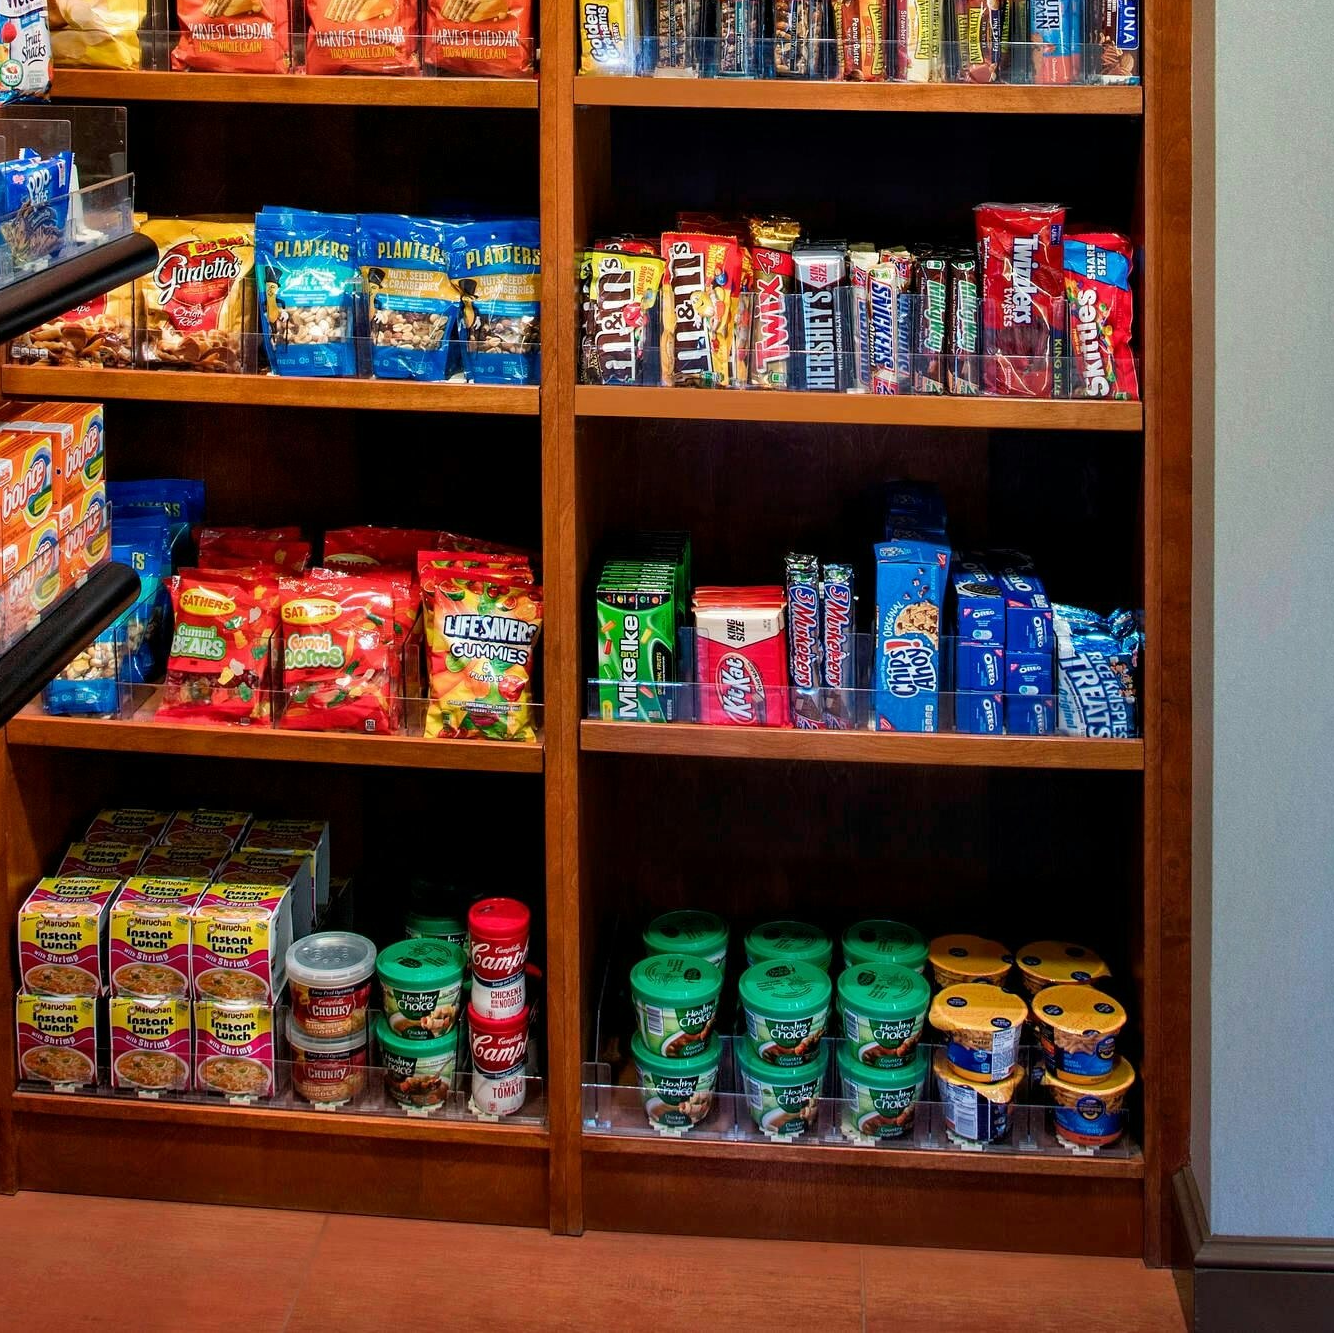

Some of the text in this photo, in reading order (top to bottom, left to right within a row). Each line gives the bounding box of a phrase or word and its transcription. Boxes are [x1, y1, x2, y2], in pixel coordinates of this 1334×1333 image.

[228, 23, 275, 40] CHEDDAR
[316, 27, 405, 47] HARVEST CHEDDAR
[585, 3, 608, 62] Golden
[22, 45, 46, 63] Snacks
[350, 46, 395, 58] WHOLE GRAIN
[274, 240, 349, 261] PLANTERS
[466, 246, 540, 267] PLANTERS
[1087, 244, 1095, 280] SHARE
[153, 254, 242, 305] Gardetto's
[872, 282, 893, 369] SNICKERS
[805, 290, 835, 389] HERSHEY'S
[182, 594, 231, 612] SATHERS
[973, 609, 995, 618] OREO
[728, 619, 736, 640] KING
[737, 620, 745, 642] SIZE
[172, 636, 224, 658] BEARS
[451, 644, 527, 664] GUMMIES
[1066, 654, 1111, 737] TREATS
[44, 919, 80, 929] Maruchan
[36, 929, 82, 941] Instant
[41, 939, 77, 951] Lunch
[47, 952, 79, 963] Shrimp
[312, 1004, 351, 1017] CHUNKY
[397, 1000, 434, 1012] Choice
[211, 1018, 256, 1031] Instant
[771, 1028, 808, 1039] Choice
[216, 1029, 251, 1041] Lunch
[493, 1085, 523, 1098] TOMATO
